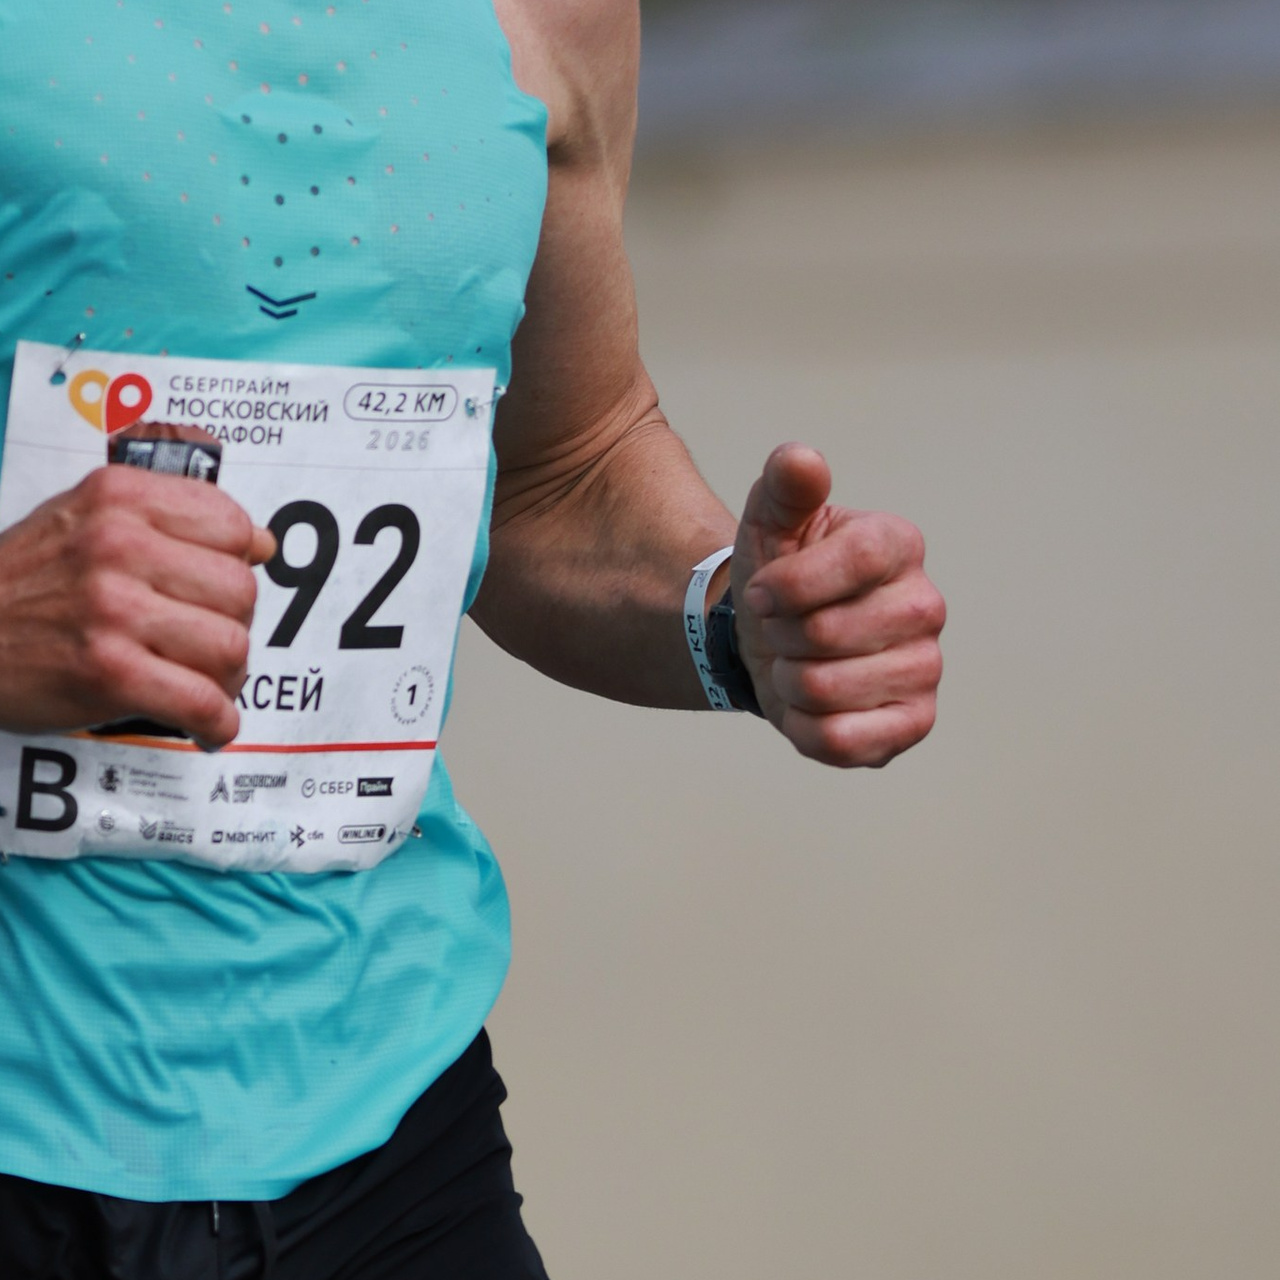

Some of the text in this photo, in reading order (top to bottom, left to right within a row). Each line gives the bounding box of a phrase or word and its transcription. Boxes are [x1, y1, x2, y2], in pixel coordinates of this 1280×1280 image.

[169, 375, 291, 396] СБЕРПРАЙМ
[166, 397, 330, 423] МОСКОВСКИЙ
[357, 391, 408, 415] 42,2
[205, 423, 283, 445] РАФОН
[365, 428, 431, 451] 2026
[264, 499, 421, 650] 92
[236, 667, 324, 712] КСЕЙ
[407, 683, 418, 706] 1
[15, 745, 79, 833] B
[319, 781, 354, 795] СБЕР
[341, 828, 377, 839] WINLINE
